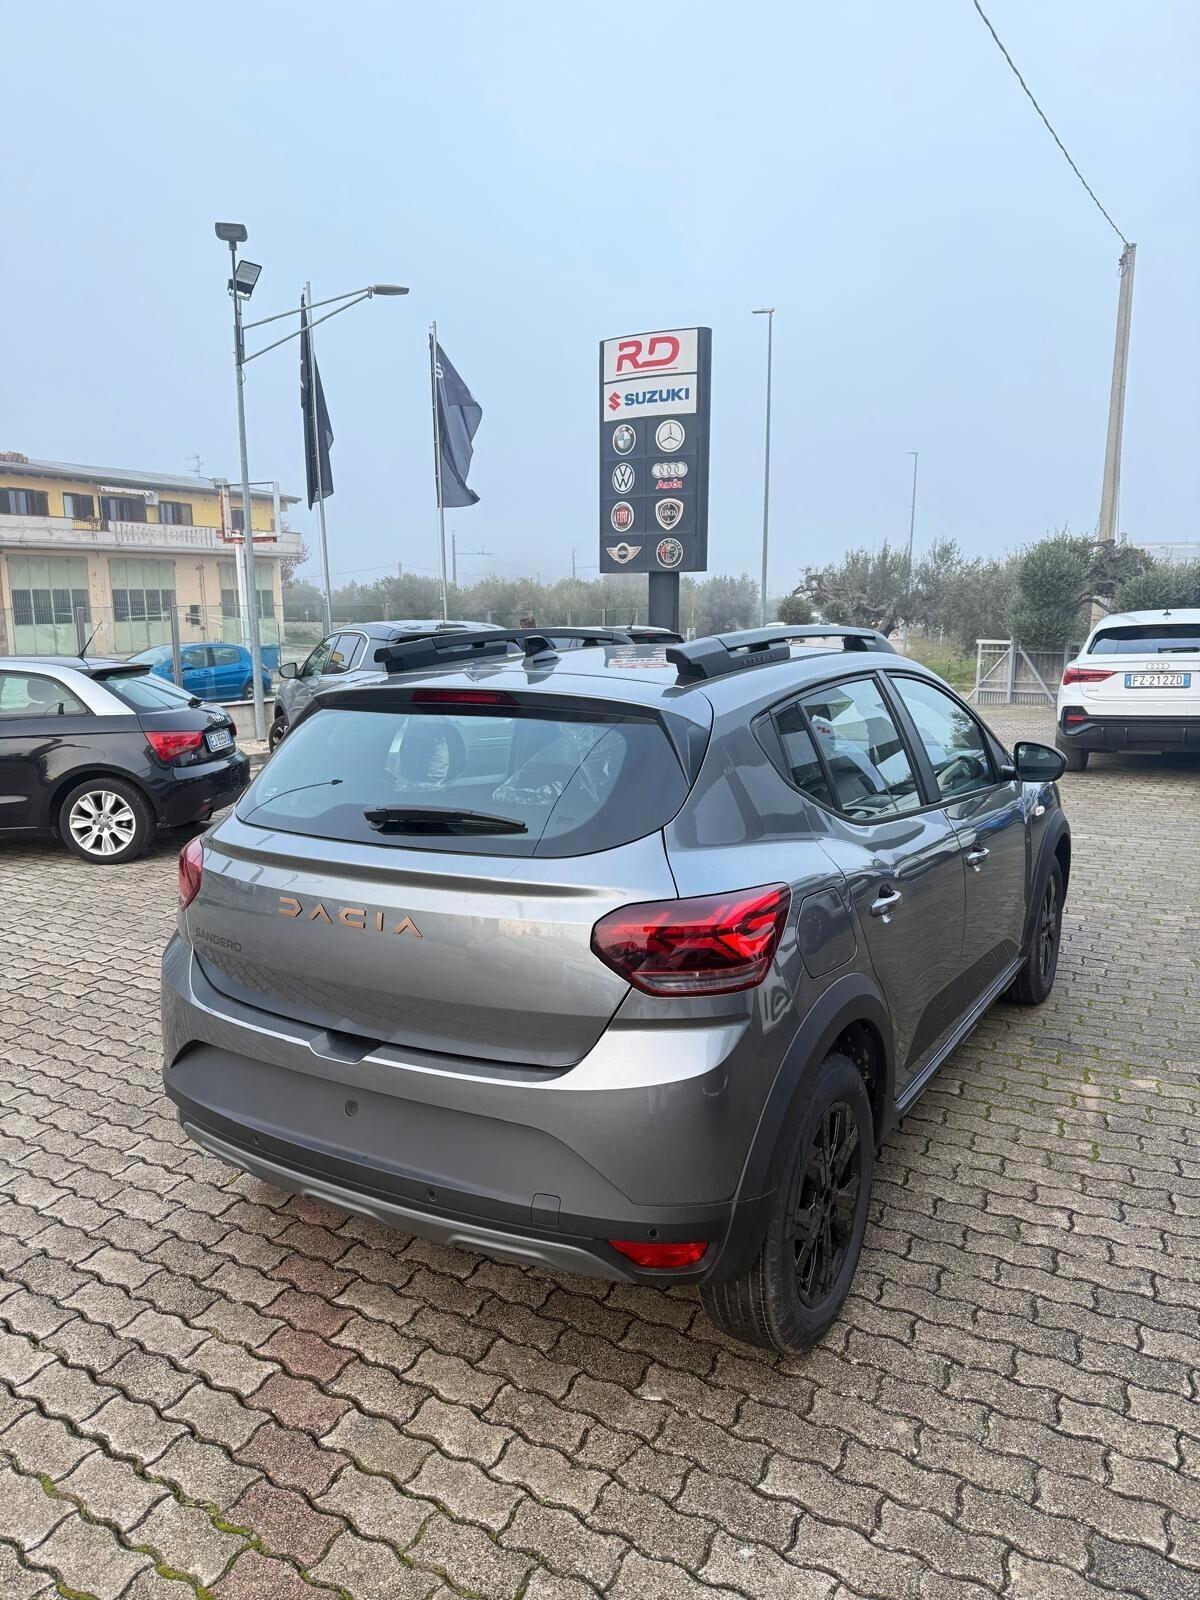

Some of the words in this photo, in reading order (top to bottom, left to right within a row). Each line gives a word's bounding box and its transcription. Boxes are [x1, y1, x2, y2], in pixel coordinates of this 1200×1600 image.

[616, 336, 680, 372] RD
[624, 388, 690, 406] SUZUKI
[656, 479, 683, 489] Audi
[279, 896, 424, 938] DACIA
[195, 927, 242, 953] SANDERO
